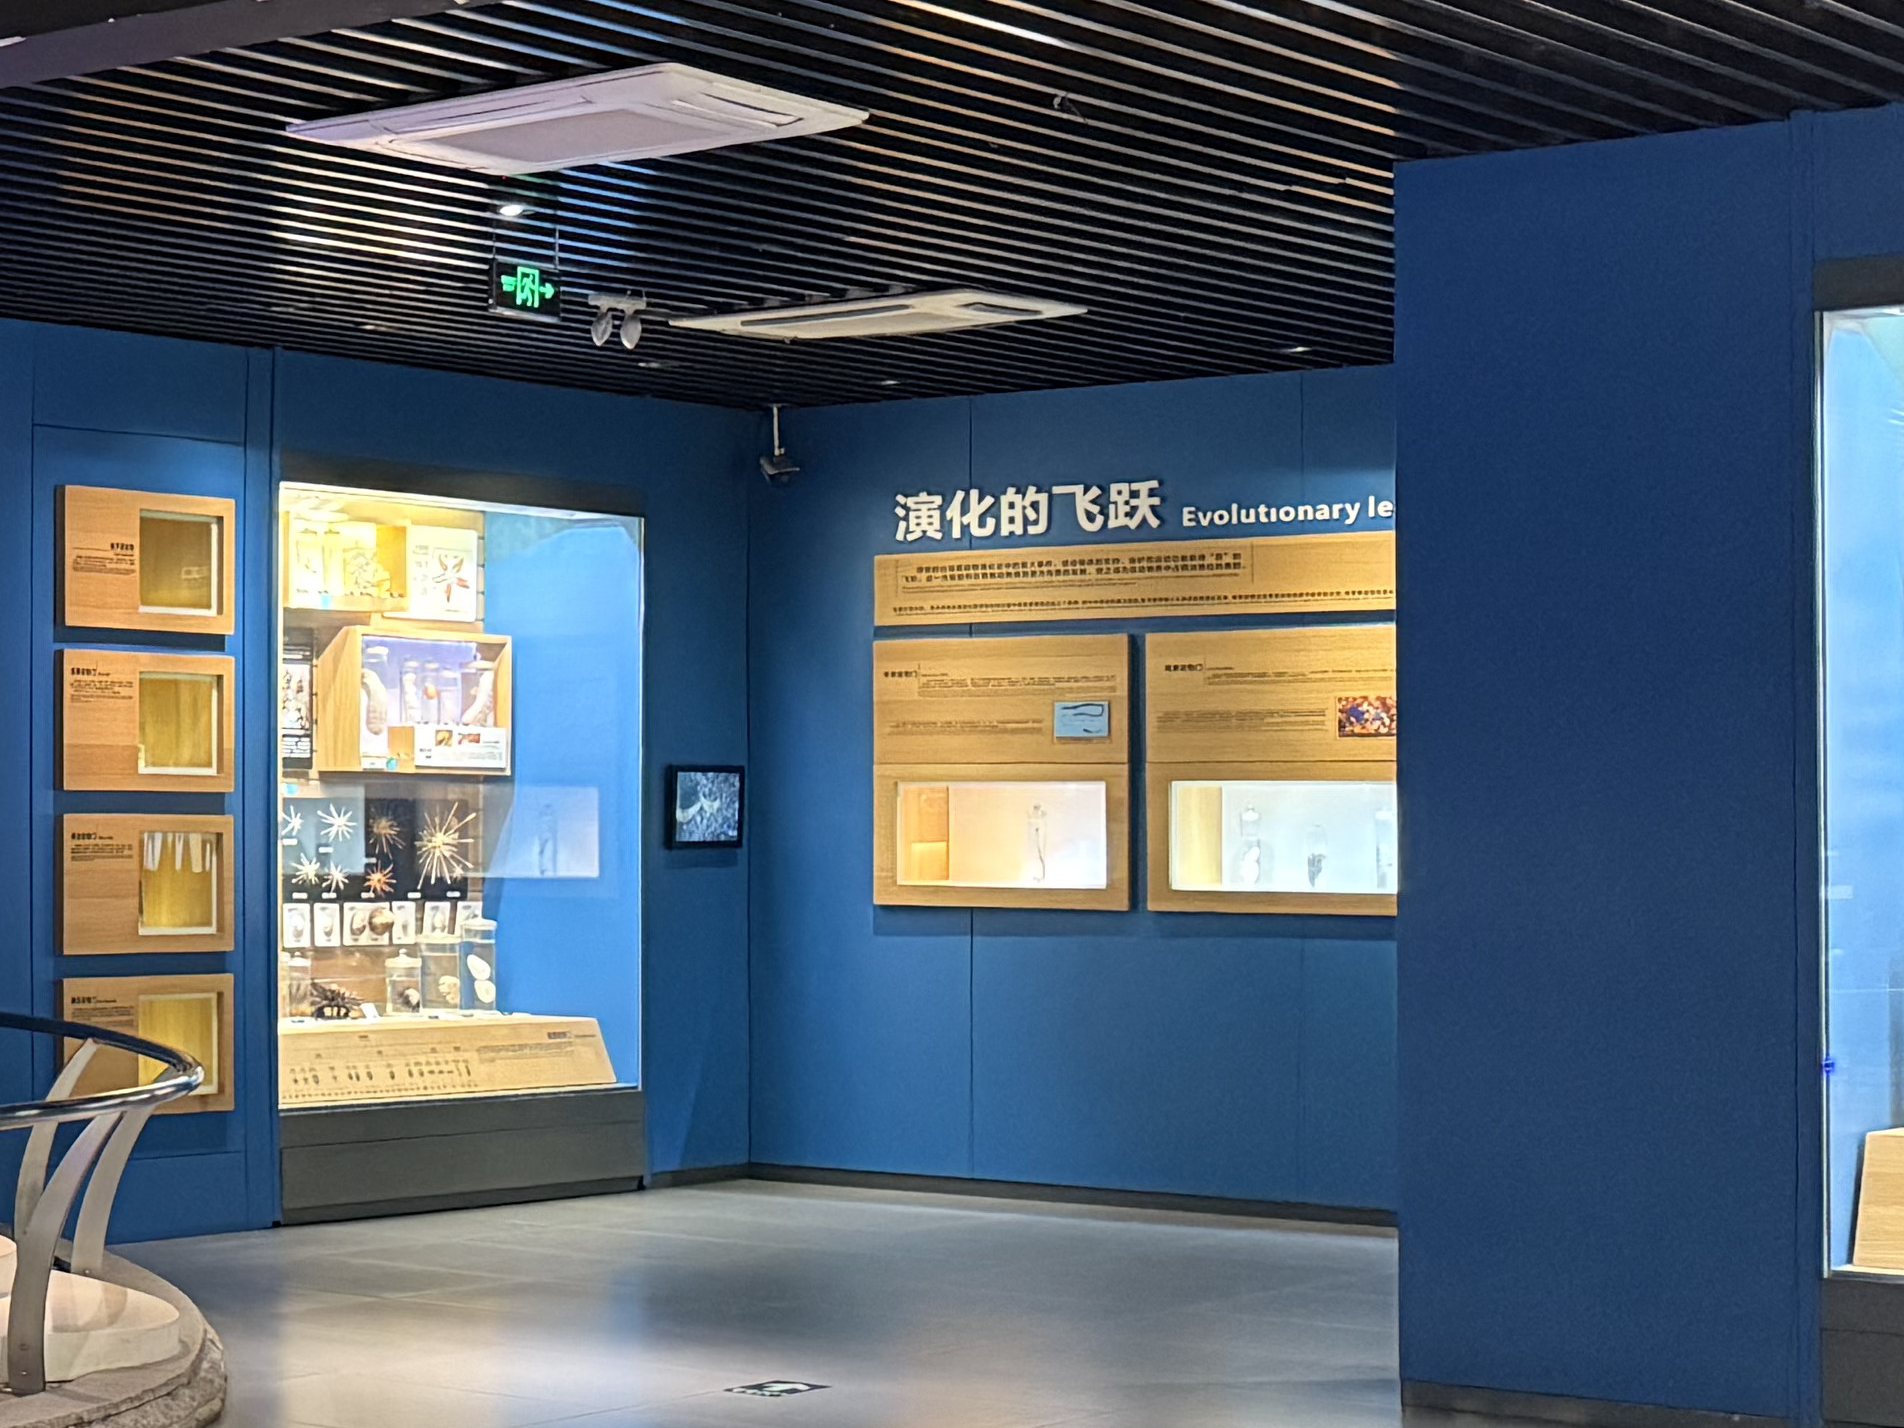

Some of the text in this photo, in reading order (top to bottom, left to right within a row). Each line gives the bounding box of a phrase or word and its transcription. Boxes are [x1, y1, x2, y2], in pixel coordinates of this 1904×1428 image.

[894, 480, 1161, 542] 演化的飞跃
[1182, 501, 1361, 527] Evolutionary
